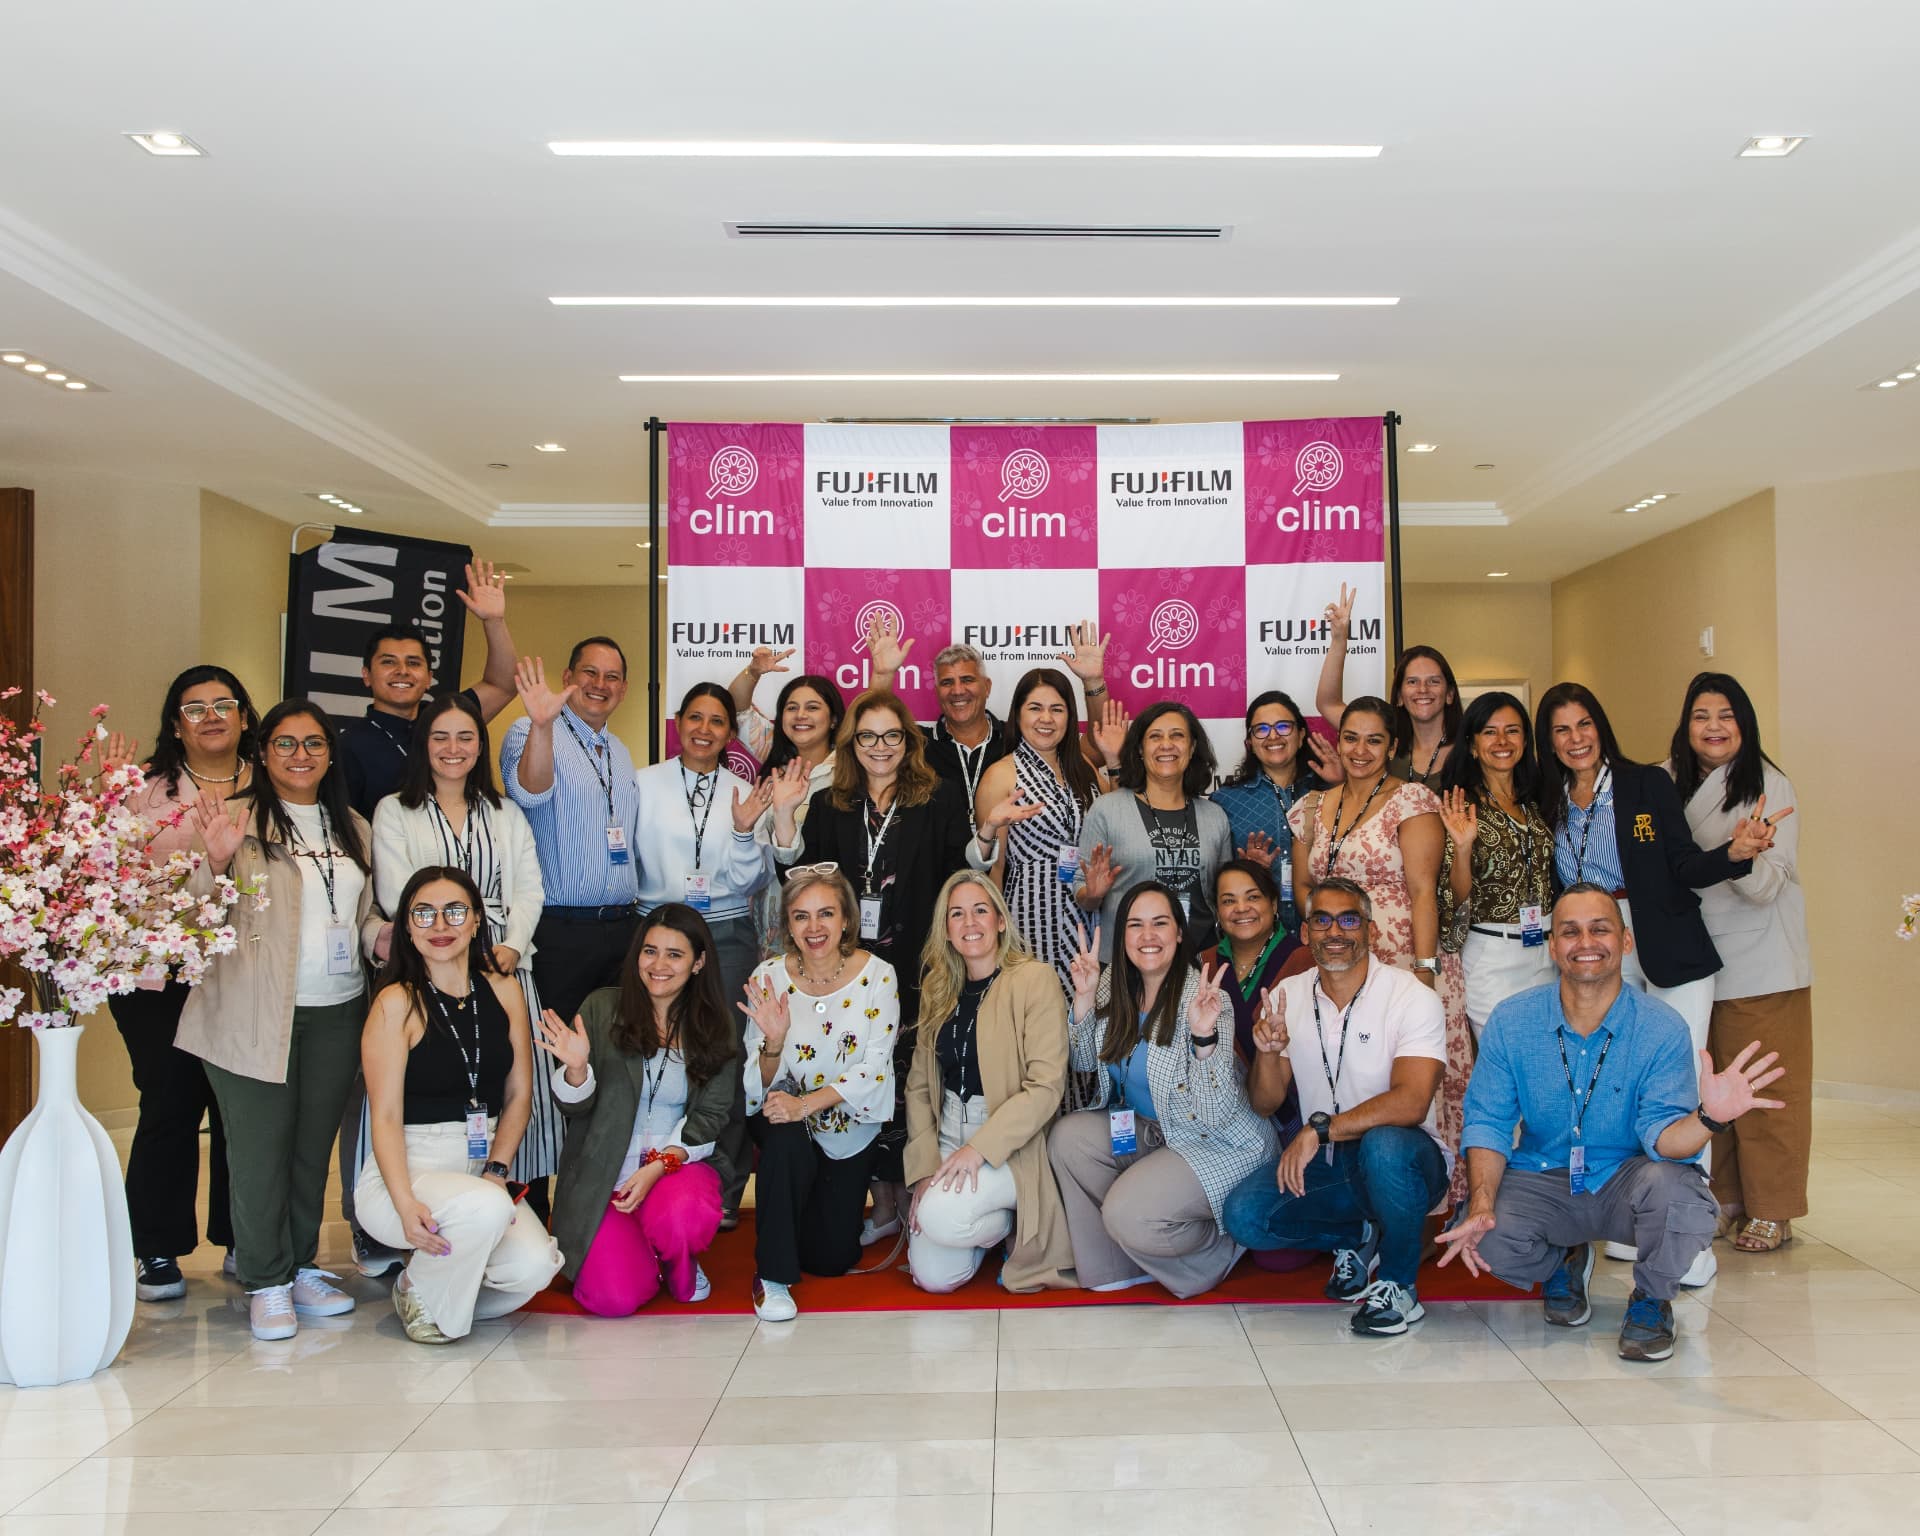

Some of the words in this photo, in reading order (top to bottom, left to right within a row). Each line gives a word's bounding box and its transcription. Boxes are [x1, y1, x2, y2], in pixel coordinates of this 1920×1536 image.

[816, 471, 938, 494] FUJIFILM
[1110, 469, 1232, 494] FUJIFILM
[821, 497, 850, 508] Value
[852, 497, 878, 508] from
[880, 498, 934, 509] Innovation
[1115, 497, 1144, 508] Value
[1147, 496, 1172, 508] from
[1174, 495, 1228, 508] Innovation
[689, 503, 774, 535] clim
[982, 506, 1066, 538] clim
[1276, 499, 1361, 533] clim
[672, 622, 795, 645] FUJIFILM
[1260, 617, 1382, 642] FUJIFLM
[676, 647, 705, 658] Value
[707, 648, 733, 658] from
[982, 650, 997, 661] lue
[1000, 651, 1025, 661] from
[1265, 646, 1292, 656] Value
[1295, 645, 1320, 655] from
[1131, 657, 1215, 689] clim
[1155, 848, 1200, 867] NTAG
